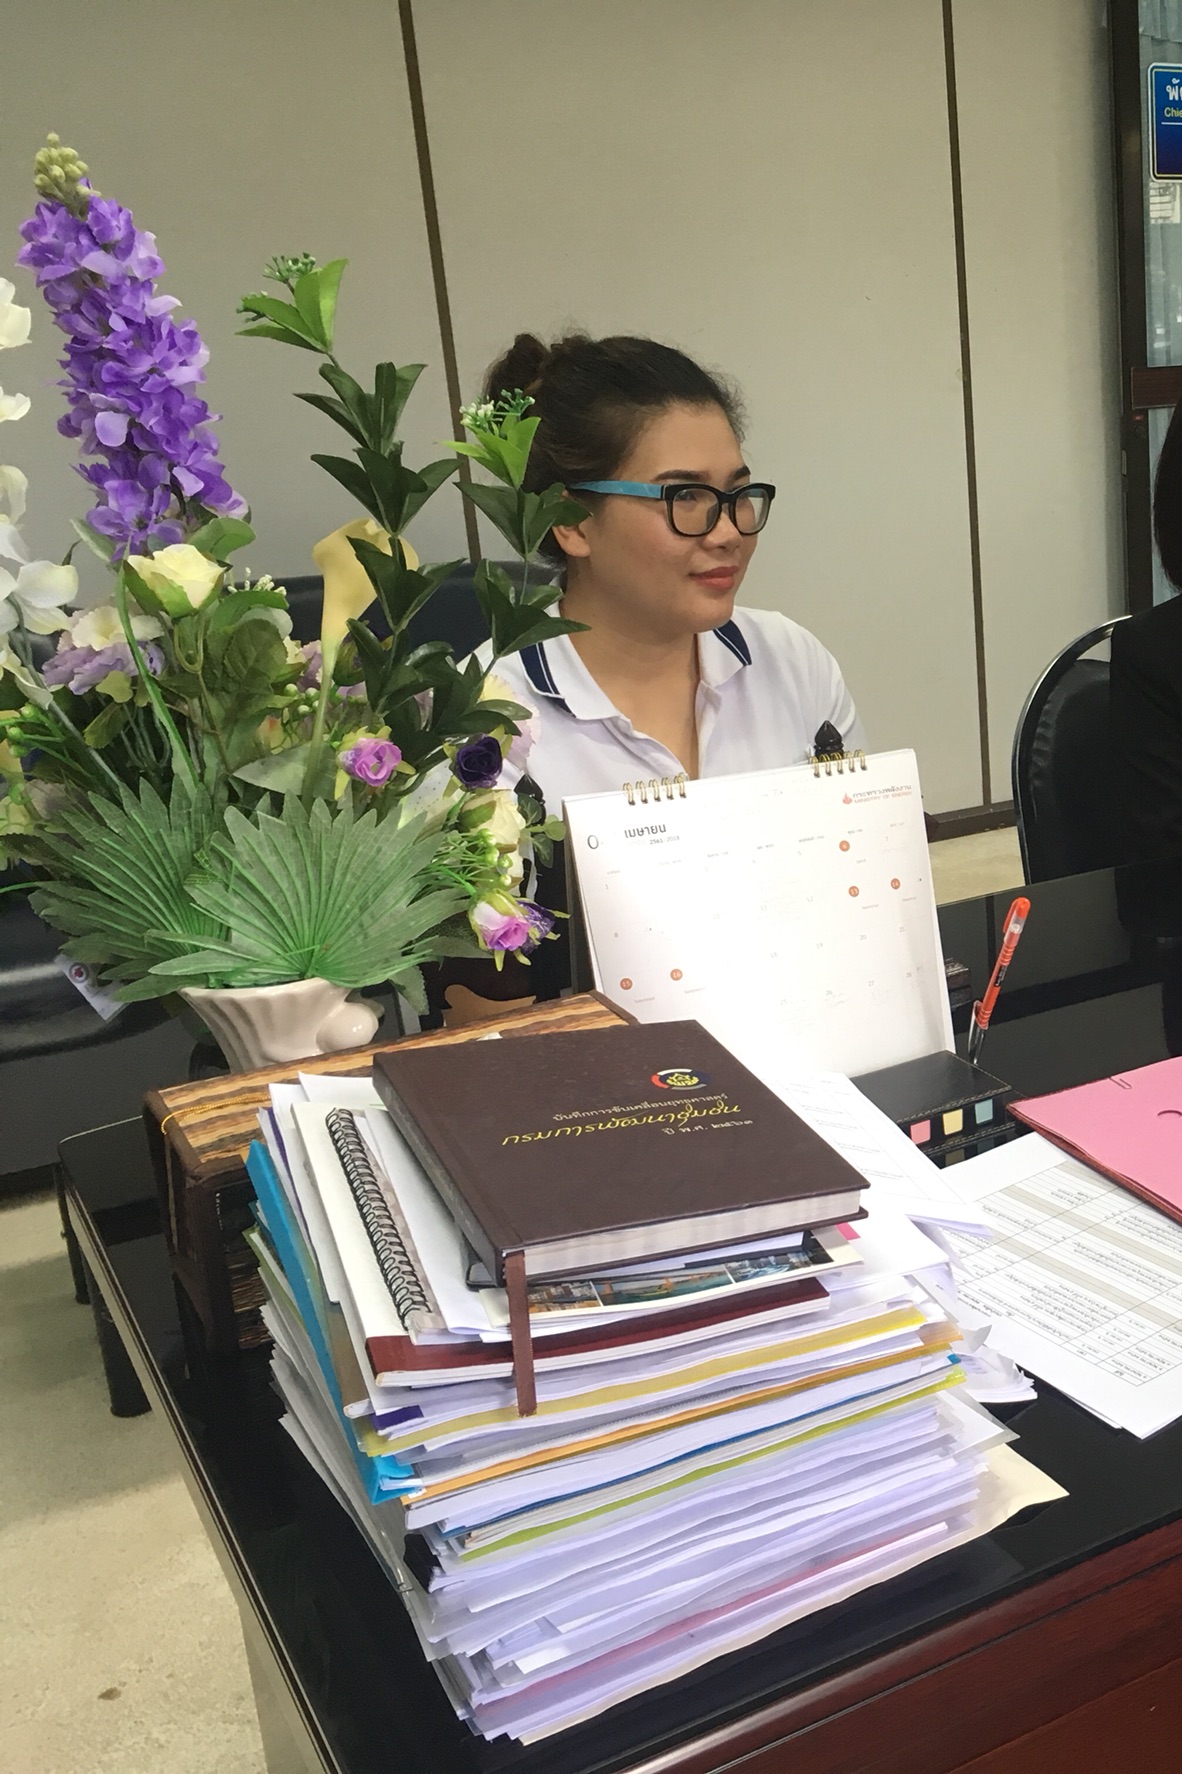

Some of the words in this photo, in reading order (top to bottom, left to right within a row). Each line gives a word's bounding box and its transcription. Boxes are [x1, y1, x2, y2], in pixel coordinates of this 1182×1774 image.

[624, 822, 667, 839] เมษายน
[649, 837, 664, 846] 2561
[661, 1126, 675, 1136] ปี
[678, 1124, 708, 1134] พ.ศ.
